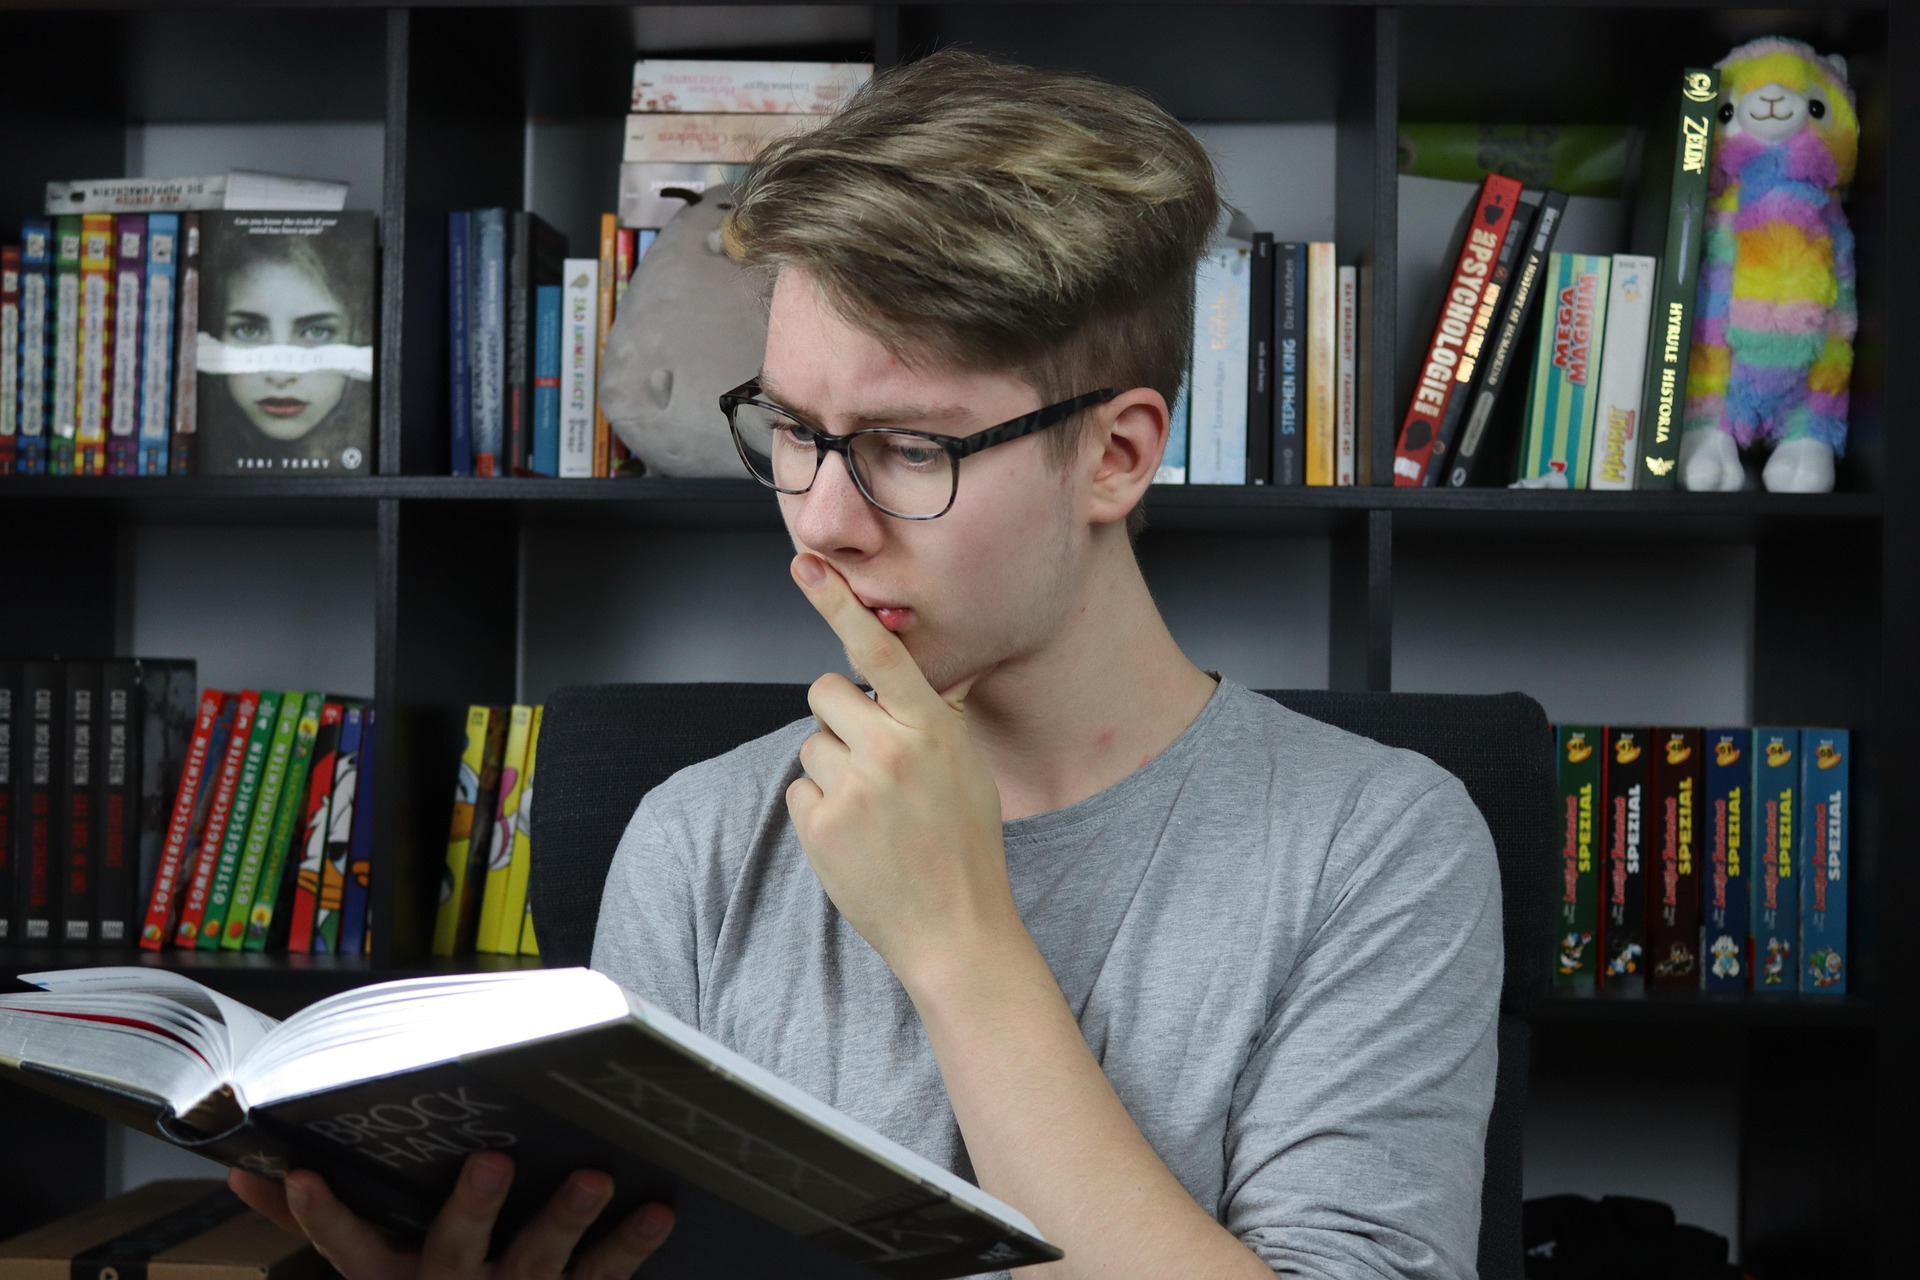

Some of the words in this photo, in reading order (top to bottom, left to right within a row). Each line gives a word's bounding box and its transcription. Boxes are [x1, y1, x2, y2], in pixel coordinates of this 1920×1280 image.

[1683, 115, 1709, 175] ZELDA
[1284, 259, 1295, 307] Mädchen
[1284, 310, 1294, 330] Das
[1418, 243, 1494, 405] PSYCHOLOGIE
[1514, 263, 1538, 310] HISTORY
[1553, 286, 1576, 369] MEGA
[1283, 338, 1296, 372] KING
[1567, 272, 1598, 385] MAGNUM
[1664, 302, 1683, 363] HYRULE
[1282, 374, 1295, 436] STEPHEN
[1656, 368, 1676, 444] HISTORIA
[153, 736, 207, 913] SOMMERGESCHICHTEN
[189, 736, 244, 911] SOMMERGESCHICHTEN
[213, 741, 263, 905] OSTERGESCHICHTEN
[236, 742, 287, 906] OSTERGESCHICHTEN
[1578, 783, 1592, 873] SPEZIAL
[1626, 783, 1641, 874] SPEZIAL
[1678, 776, 1692, 875] SPEZIAL
[1728, 786, 1741, 877] SPEZIAL
[1779, 787, 1792, 878] SPEZIAL
[1828, 790, 1841, 881] SPEZIAL
[305, 1086, 511, 1145] BROCK
[354, 1121, 518, 1169] HAUS
